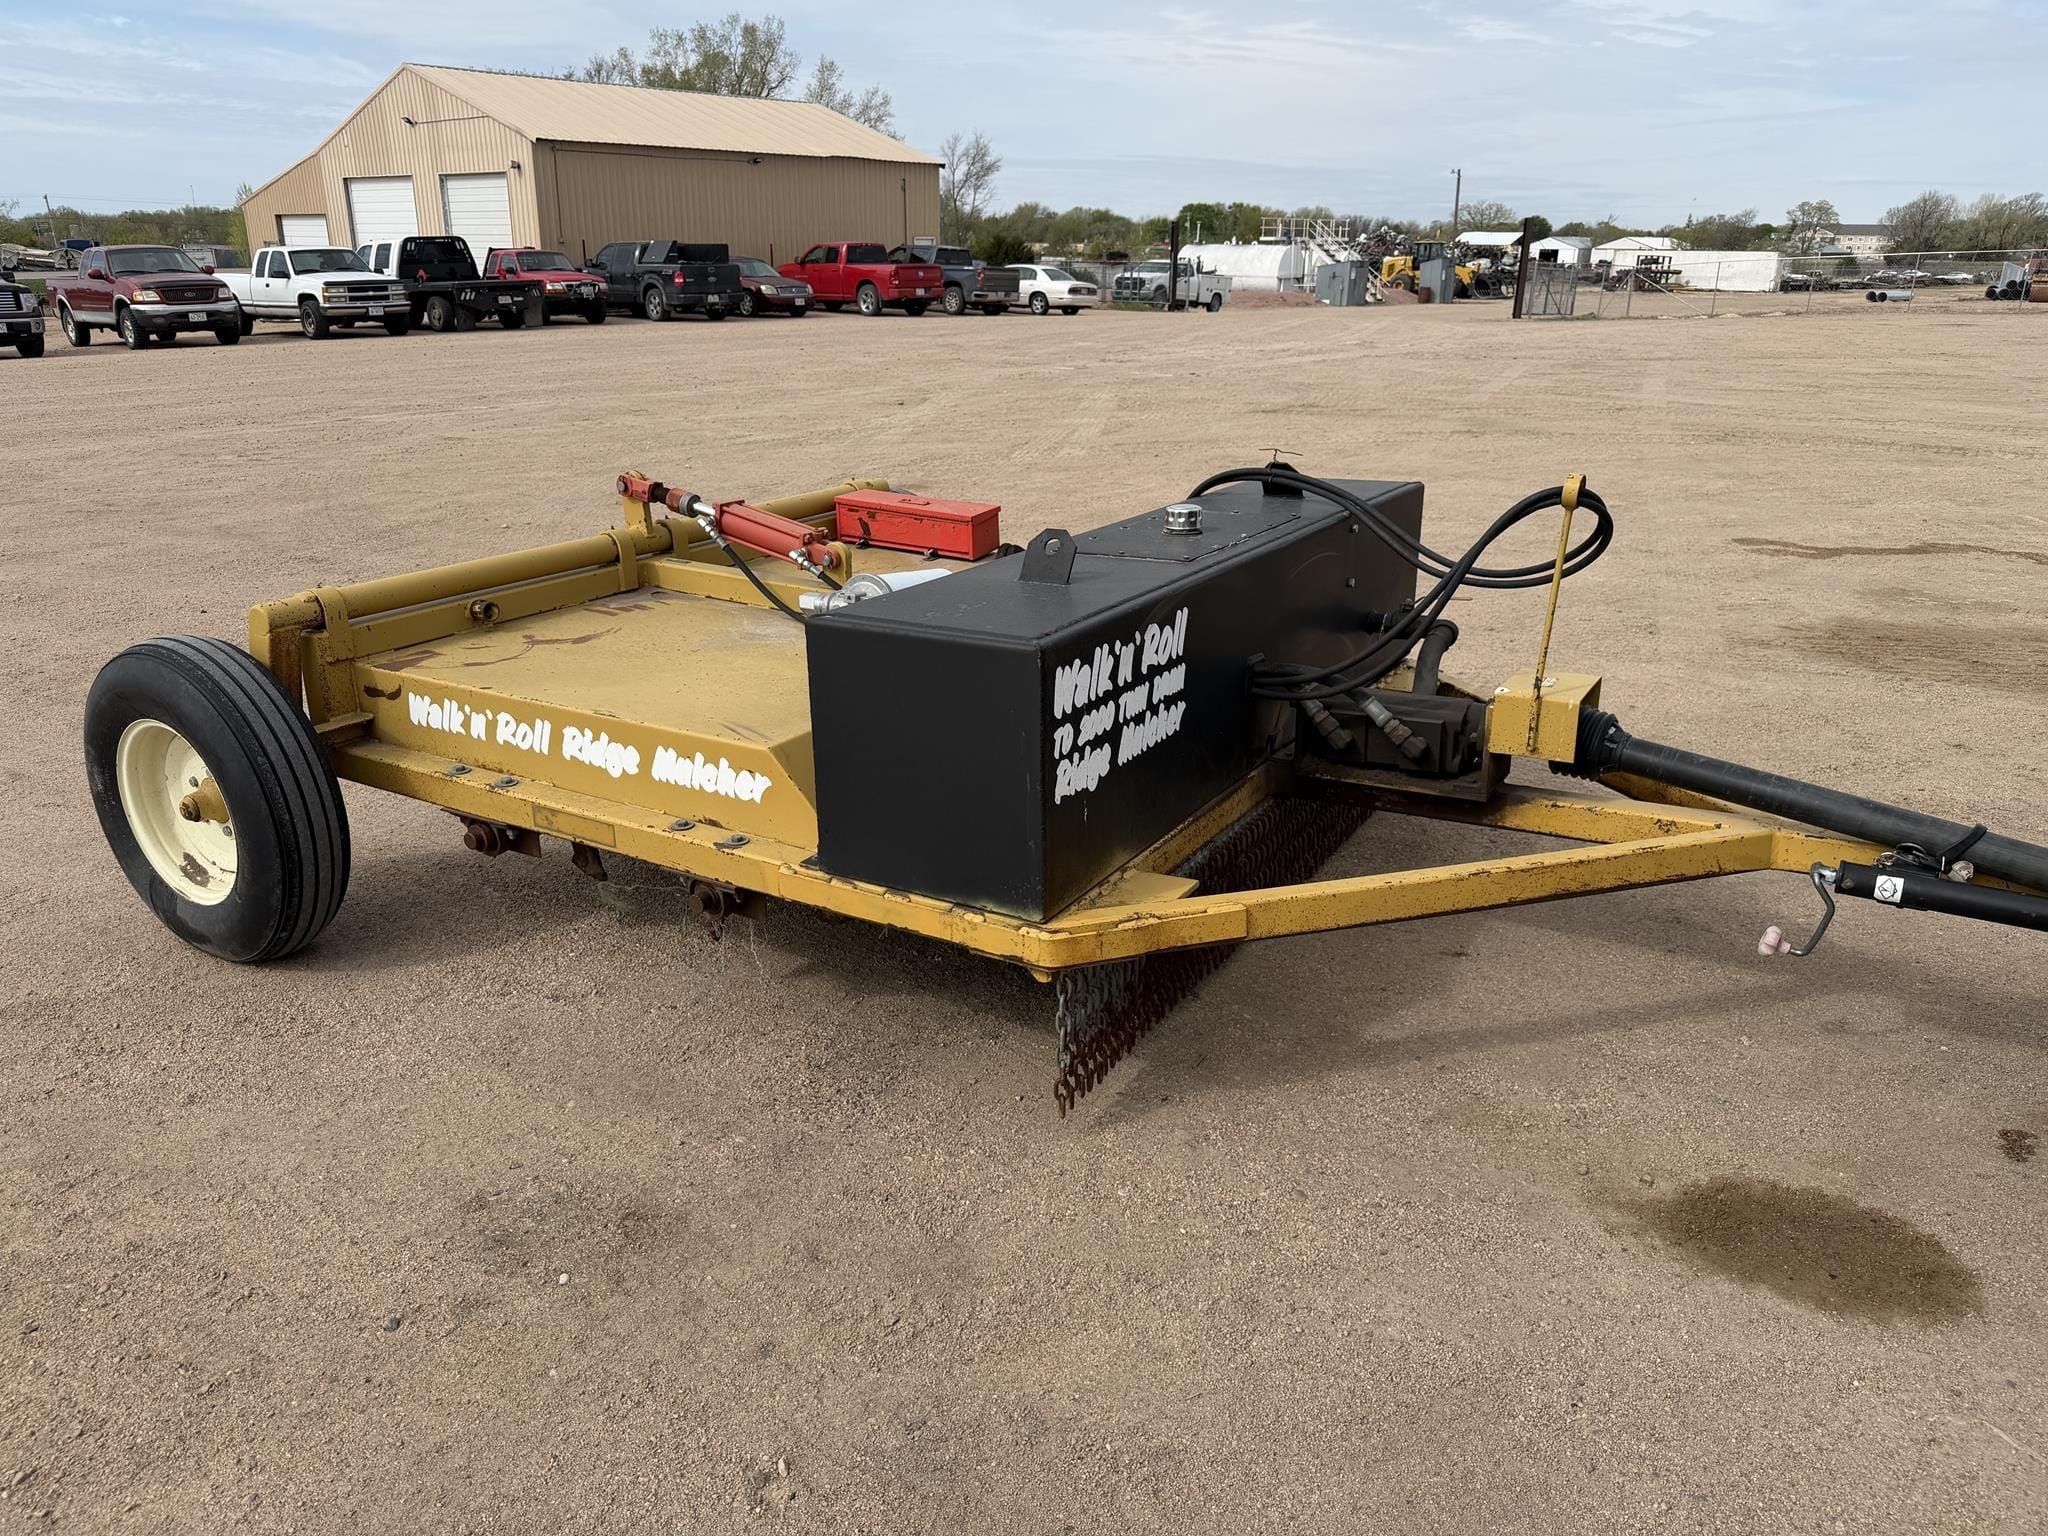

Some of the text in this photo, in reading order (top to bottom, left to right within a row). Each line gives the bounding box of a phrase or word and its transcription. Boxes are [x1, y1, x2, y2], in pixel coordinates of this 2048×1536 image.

[562, 725, 641, 778] Ridge
[651, 745, 772, 804] Mulcher
[1053, 722, 1074, 760] TO
[1054, 700, 1187, 805] Ridge Mulcher
